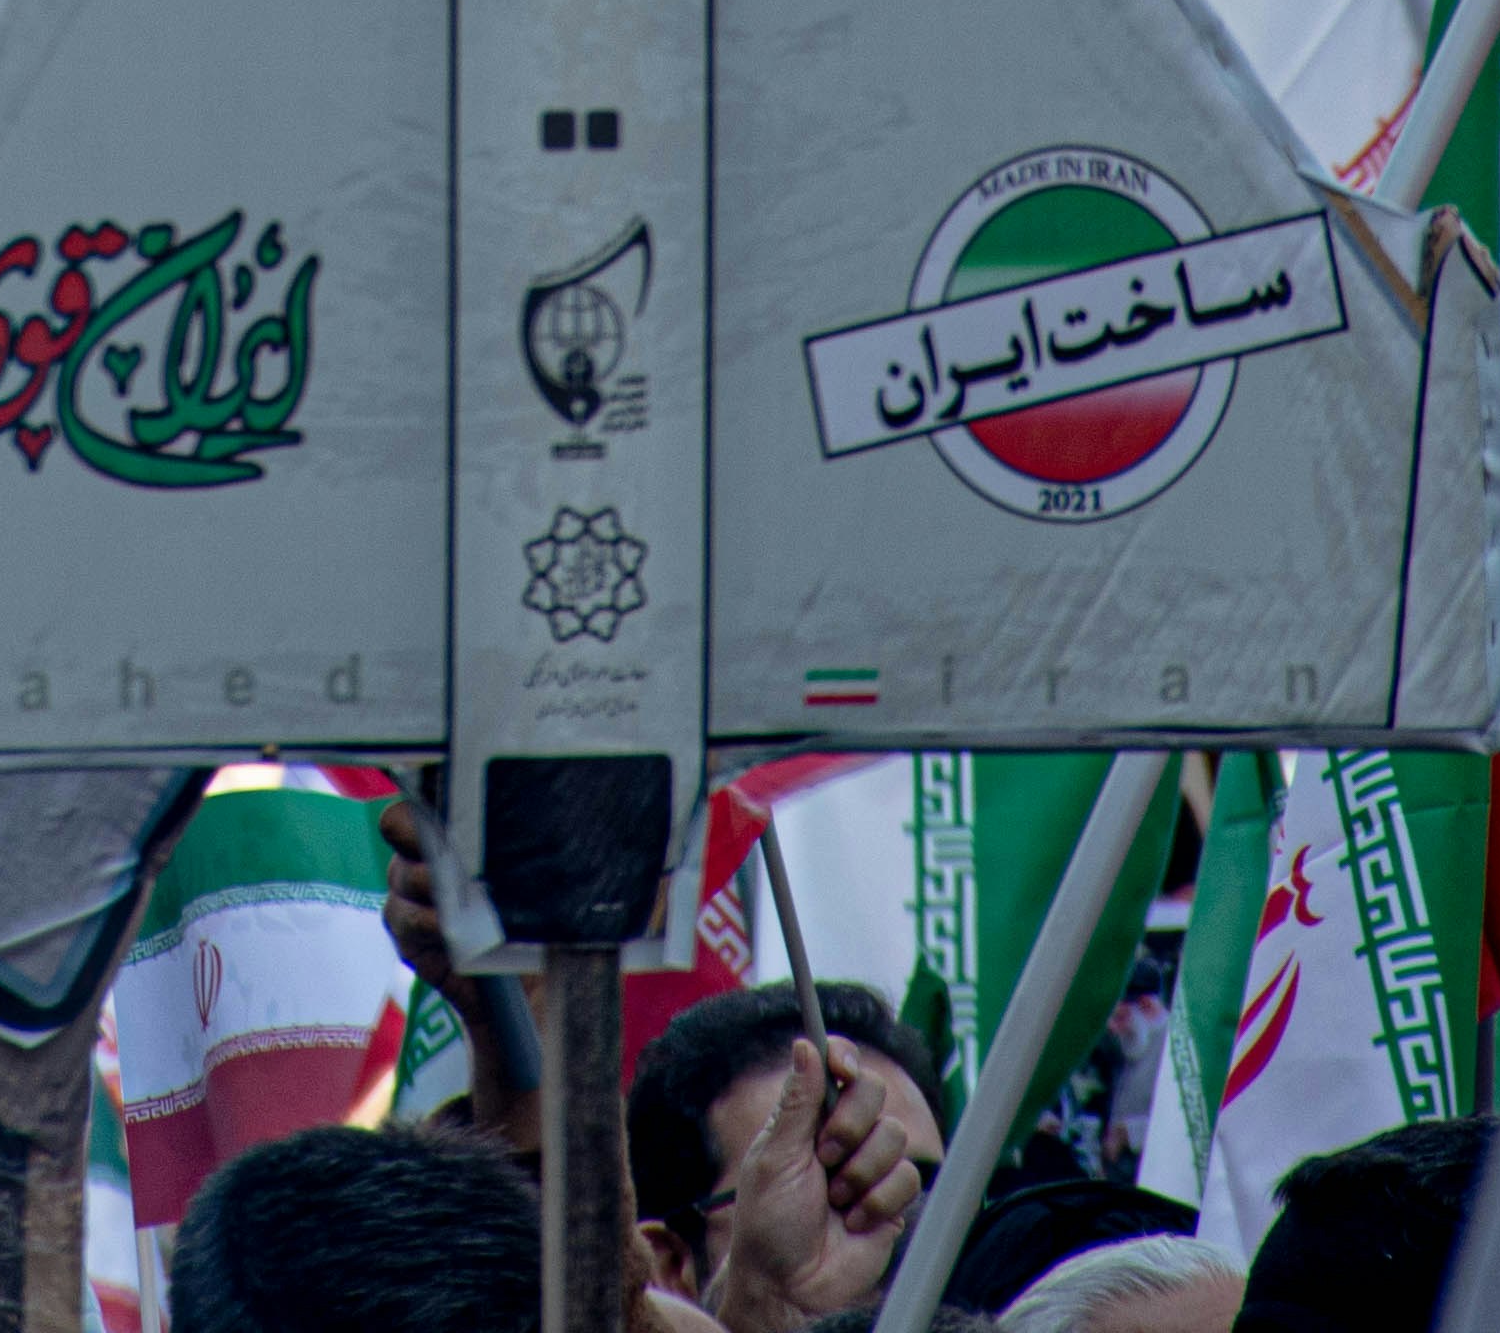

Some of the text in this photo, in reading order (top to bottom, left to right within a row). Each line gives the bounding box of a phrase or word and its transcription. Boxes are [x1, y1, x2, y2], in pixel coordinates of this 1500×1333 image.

[978, 154, 1149, 202] MADE IN IRAN
[54, 208, 322, 492] ایران
[874, 259, 1294, 429] ساخت ایران
[1036, 487, 1103, 514] 2021
[940, 653, 1321, 707] iran
